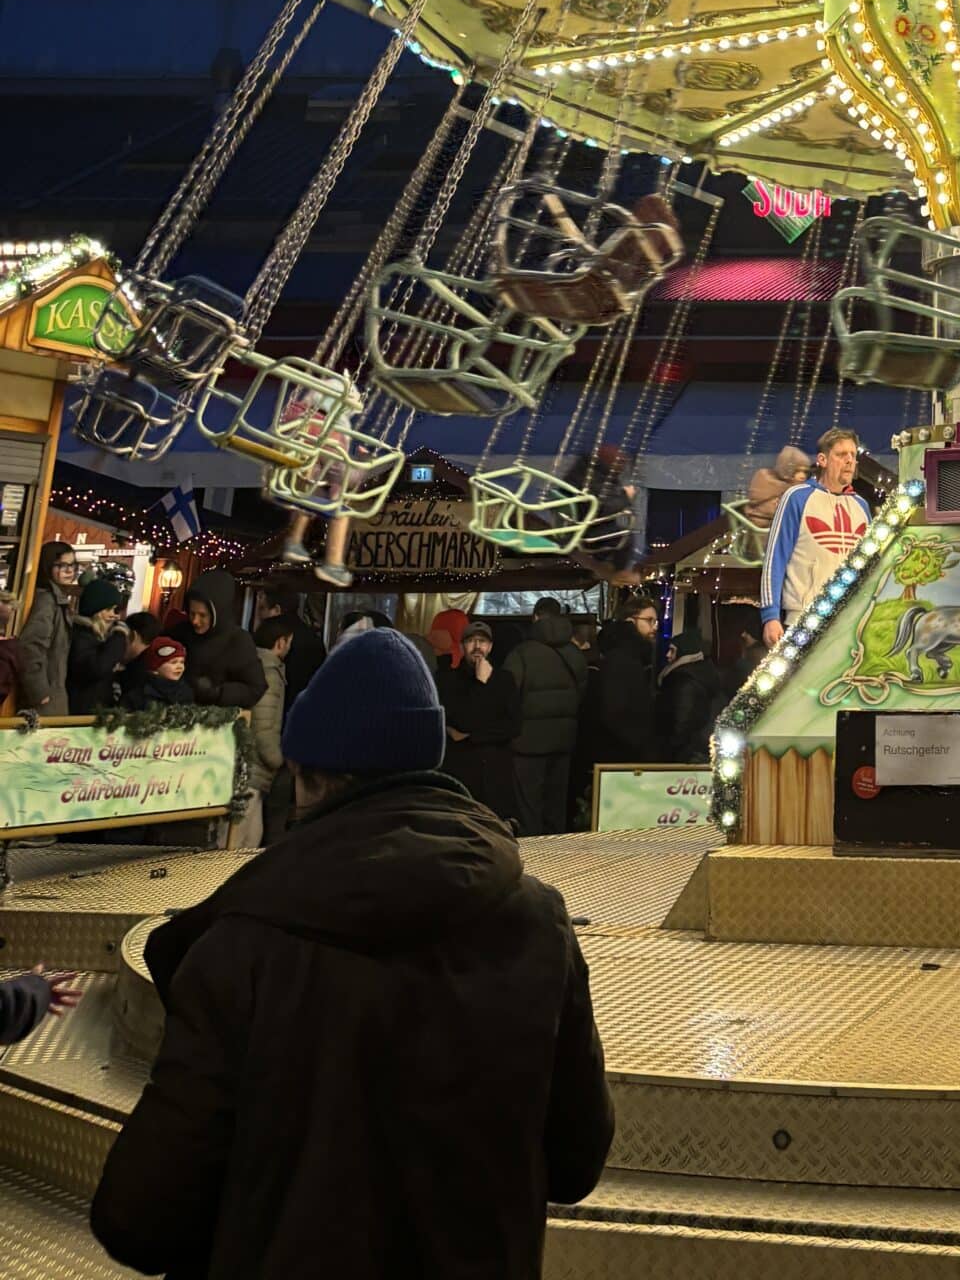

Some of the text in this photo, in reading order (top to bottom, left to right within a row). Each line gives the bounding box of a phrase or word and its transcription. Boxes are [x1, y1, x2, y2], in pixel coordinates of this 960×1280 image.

[43, 738, 93, 764] Wenn
[98, 736, 148, 768] Signal
[883, 744, 951, 758] Rutschgefahr
[60, 777, 141, 804] Fahrbahn
[140, 774, 171, 804] frei
[656, 808, 682, 825] ab
[686, 809, 699, 824] 2
